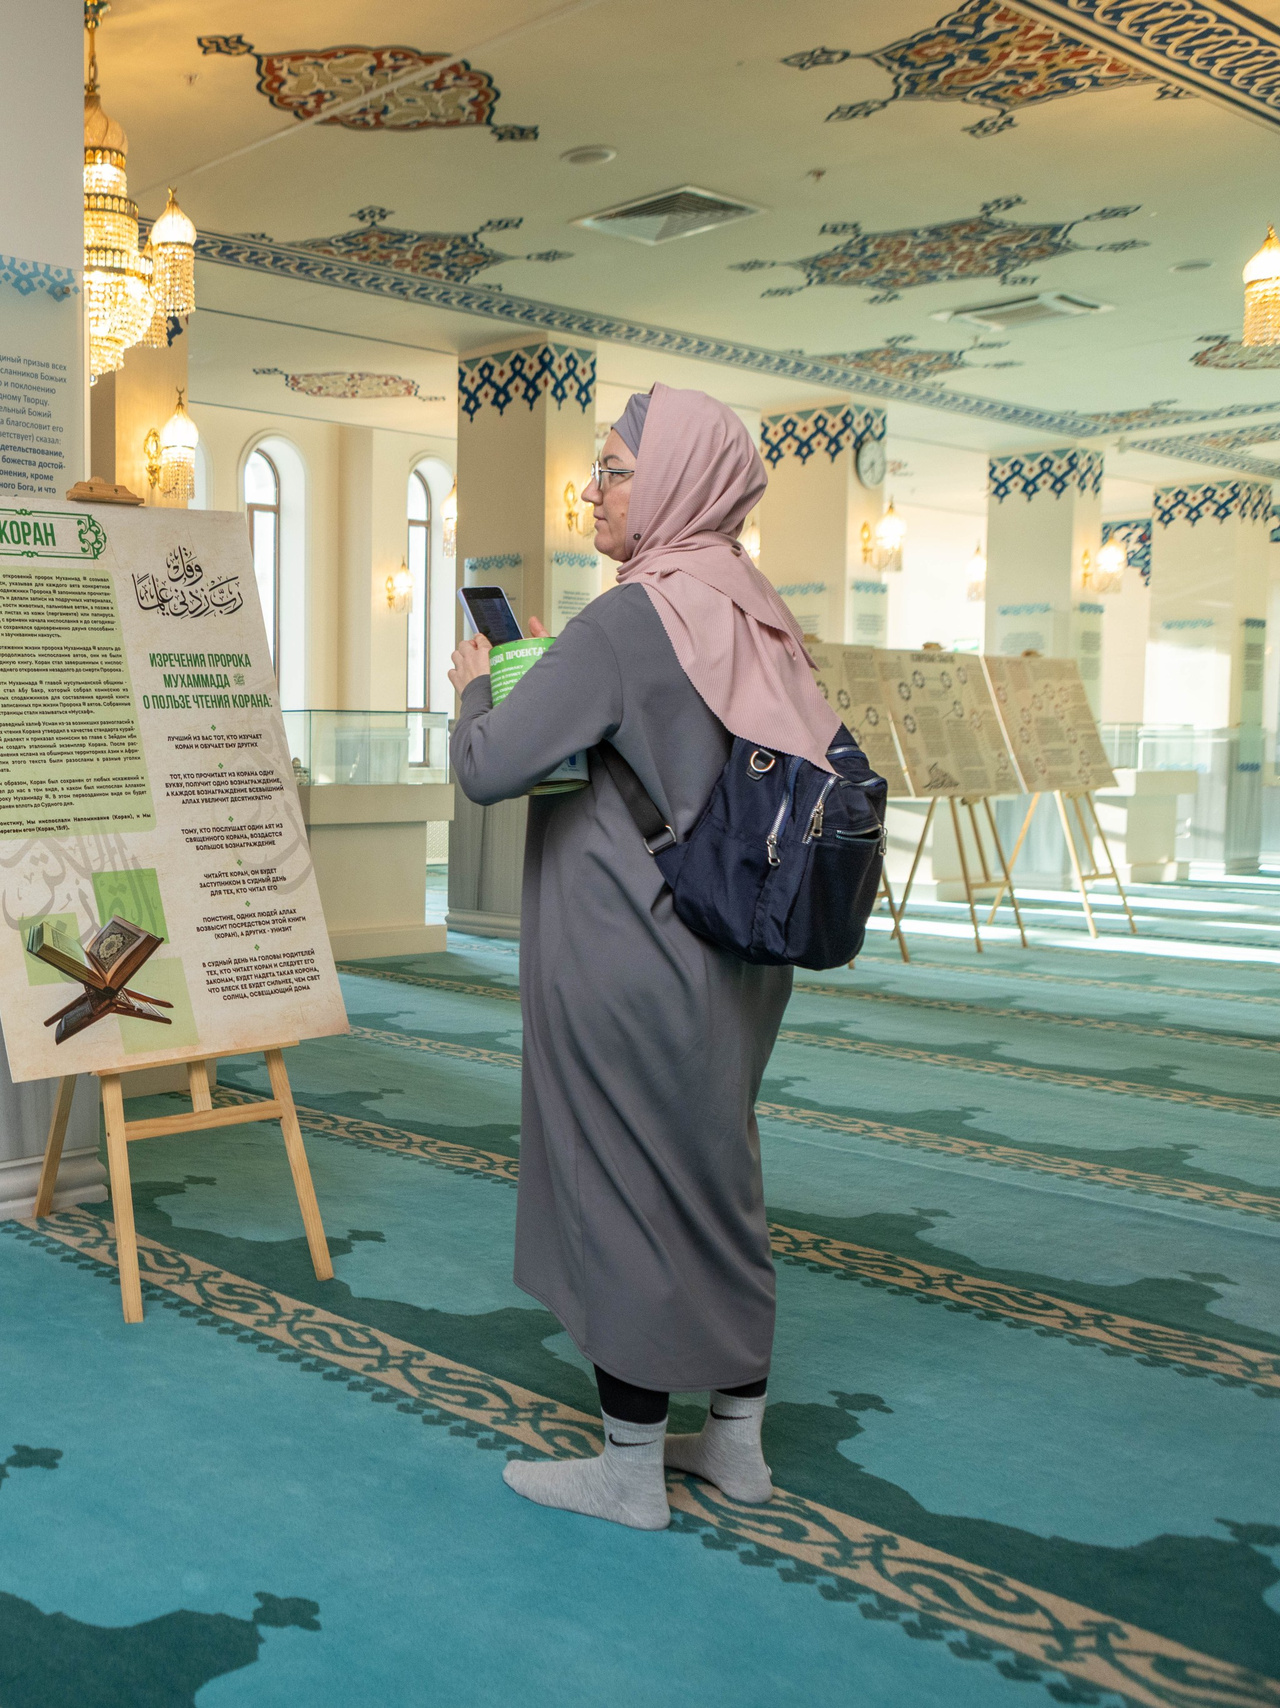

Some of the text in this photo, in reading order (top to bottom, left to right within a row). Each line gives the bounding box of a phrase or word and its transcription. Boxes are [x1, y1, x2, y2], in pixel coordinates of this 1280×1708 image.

[23, 359, 50, 368] призыв
[40, 372, 66, 383] Божьих
[11, 382, 56, 394] поклонению
[24, 395, 49, 407] Творцу.
[28, 408, 51, 418] Божий
[6, 418, 50, 430] благословит
[36, 436, 61, 444] сказал:
[2, 455, 36, 466] божества
[18, 482, 36, 492] Бога,
[149, 654, 251, 667] ИЗРЕЧЕНИЯ ПРОРОКА
[163, 674, 230, 688] МУХАММАДА
[143, 694, 272, 709] О ПОЛЬЗЕ ЧТЕНИЯ КОРАНА:
[228, 920, 270, 928] ПОСРЕДСТВОМ
[208, 958, 232, 967] СУДНЫЙ
[283, 949, 315, 958] РОДИТЕЛЕЙ
[250, 986, 293, 997] ОСВЕЩАЮЩИЙ
